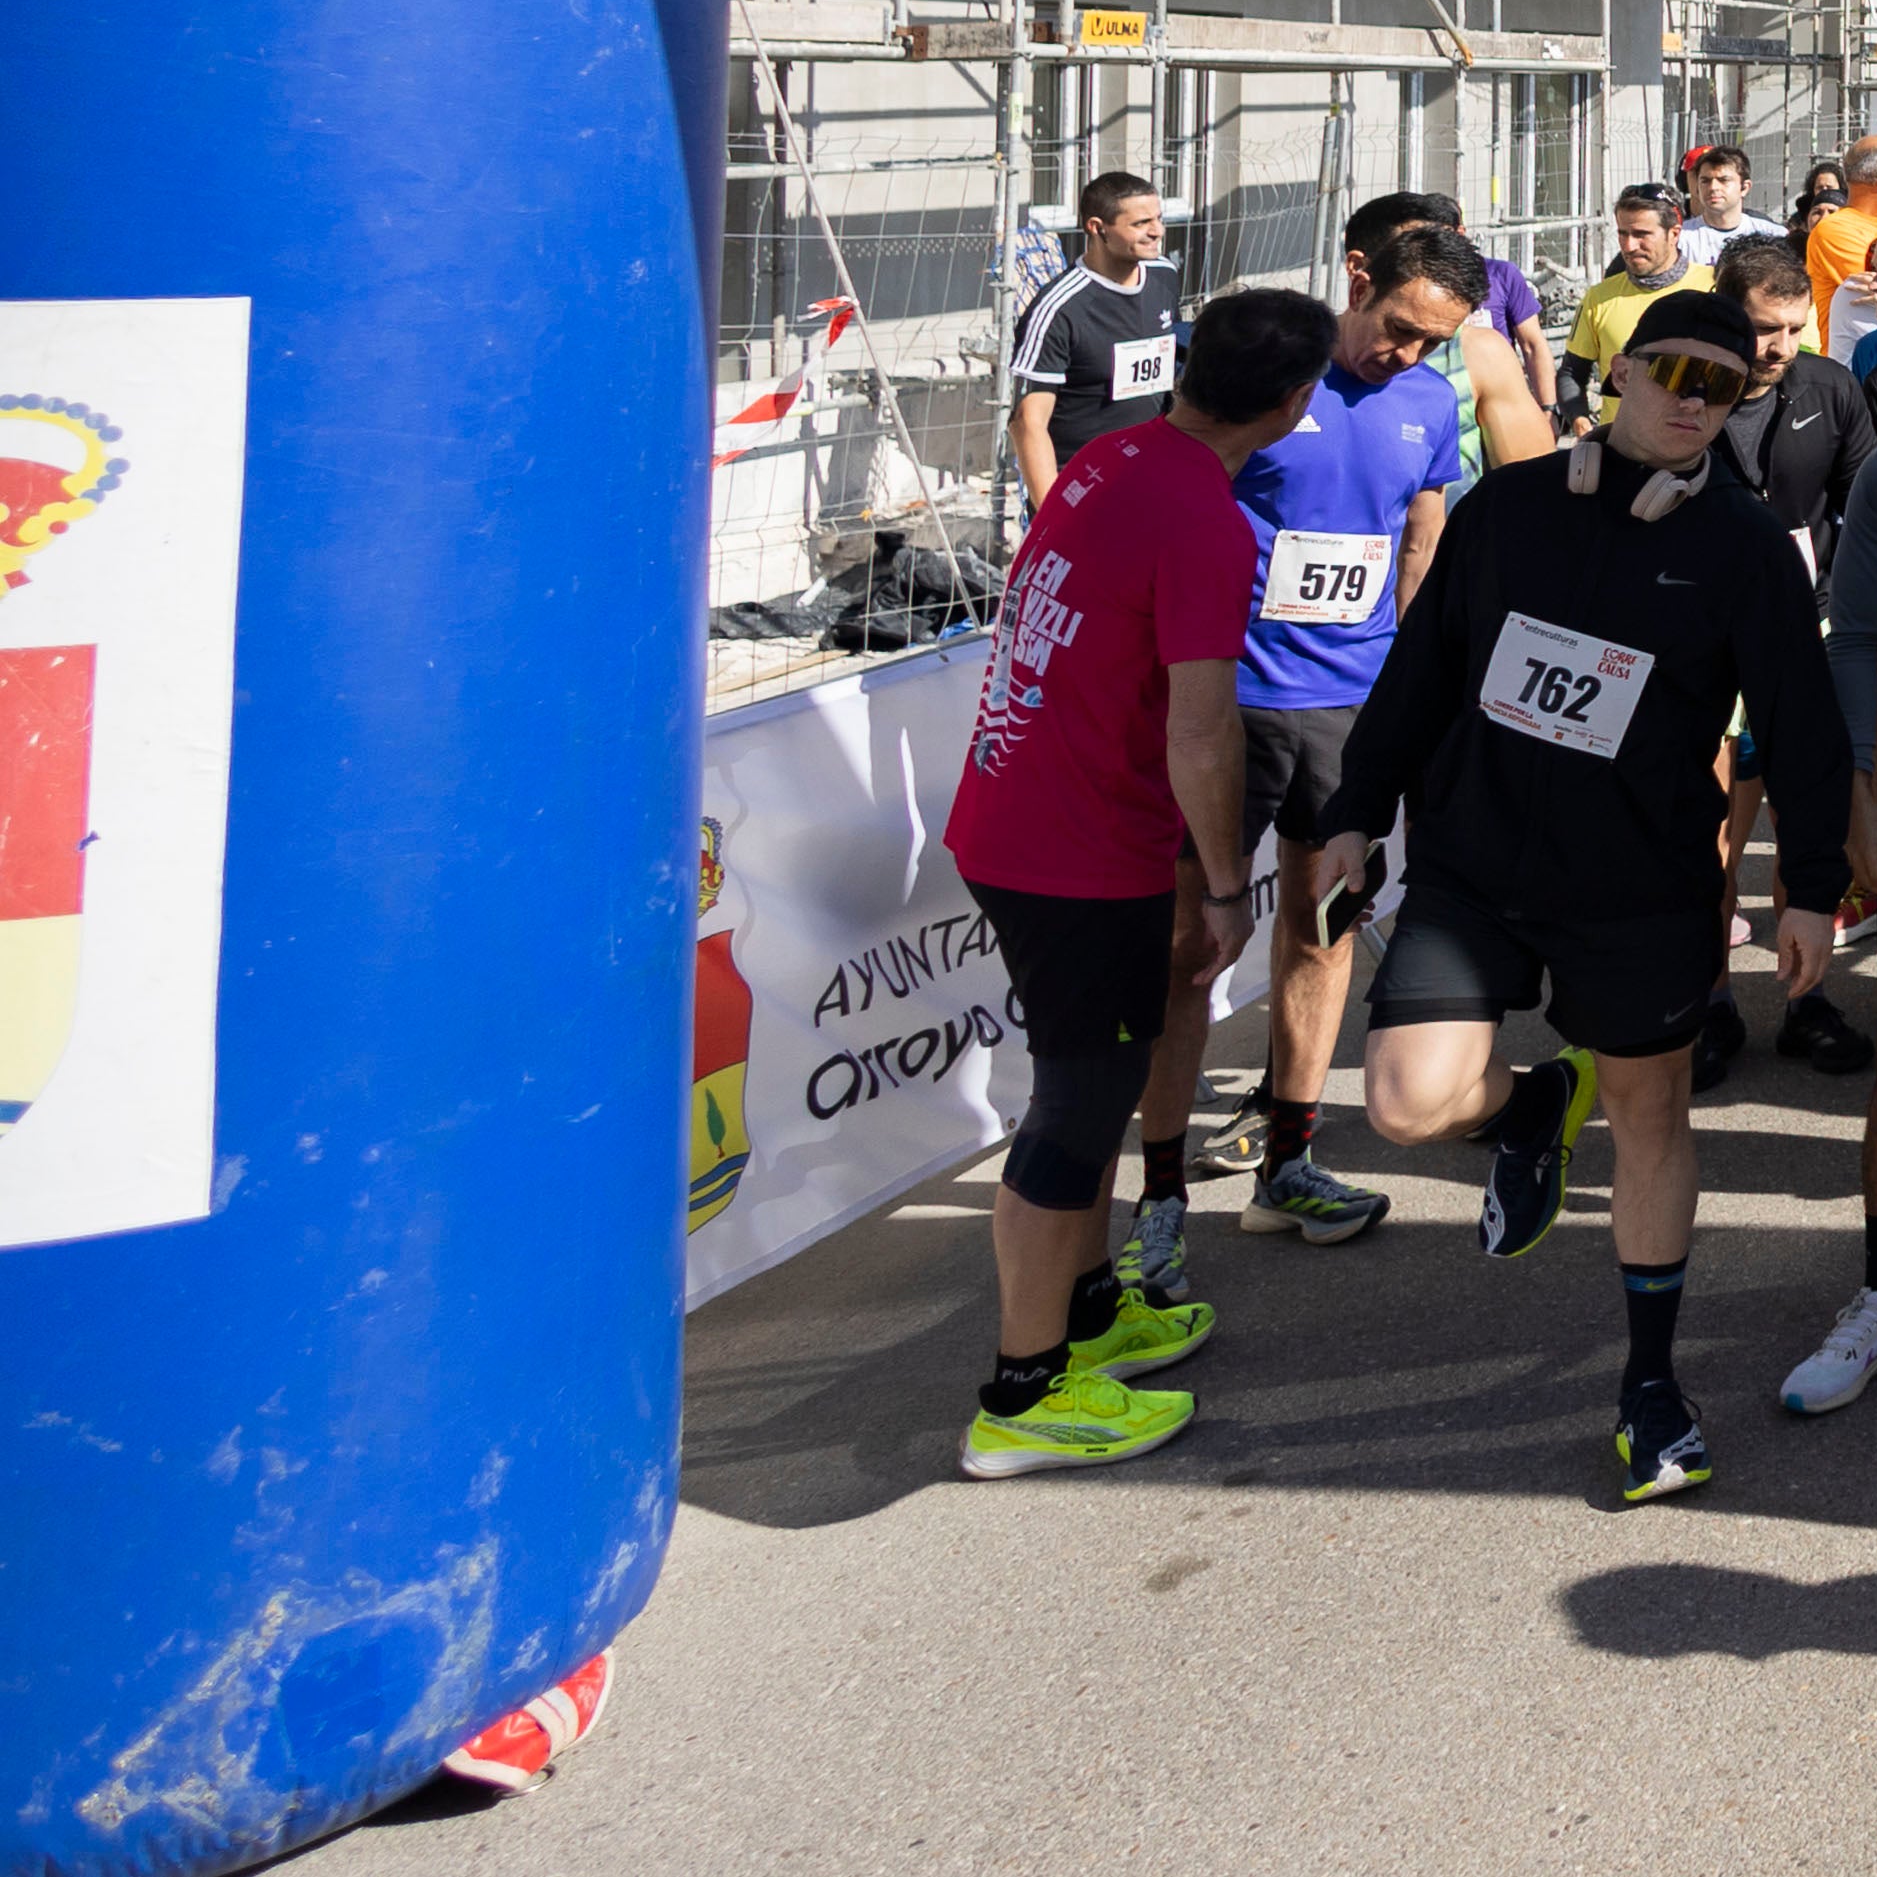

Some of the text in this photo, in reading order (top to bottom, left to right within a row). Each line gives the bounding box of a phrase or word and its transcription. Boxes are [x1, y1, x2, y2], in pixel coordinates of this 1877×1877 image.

[1106, 23, 1140, 37] ULMA
[1131, 356, 1162, 383] 198
[1300, 562, 1367, 602] 579
[1525, 624, 1579, 647] entreculturas
[1603, 647, 1638, 666] CORRE
[1597, 661, 1631, 681] CAUSA
[1517, 656, 1602, 724] 762
[813, 911, 1001, 1029] AYUNTA
[1001, 1366, 1051, 1383] FILA
